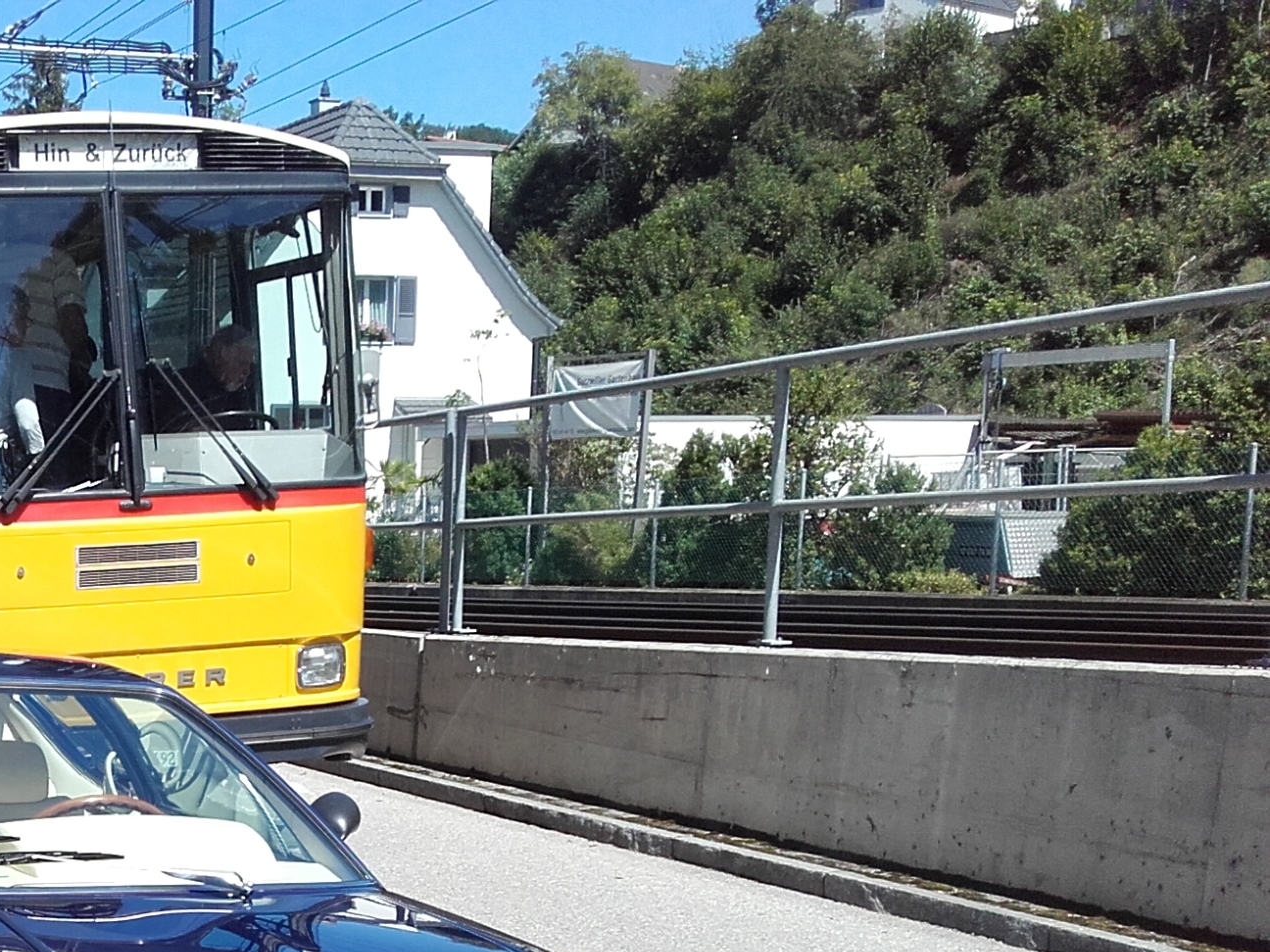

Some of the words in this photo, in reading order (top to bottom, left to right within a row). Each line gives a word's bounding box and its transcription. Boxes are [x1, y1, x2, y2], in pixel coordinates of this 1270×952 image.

[34, 143, 71, 163] Hin
[85, 142, 101, 163] &
[113, 143, 187, 163] Zurück
